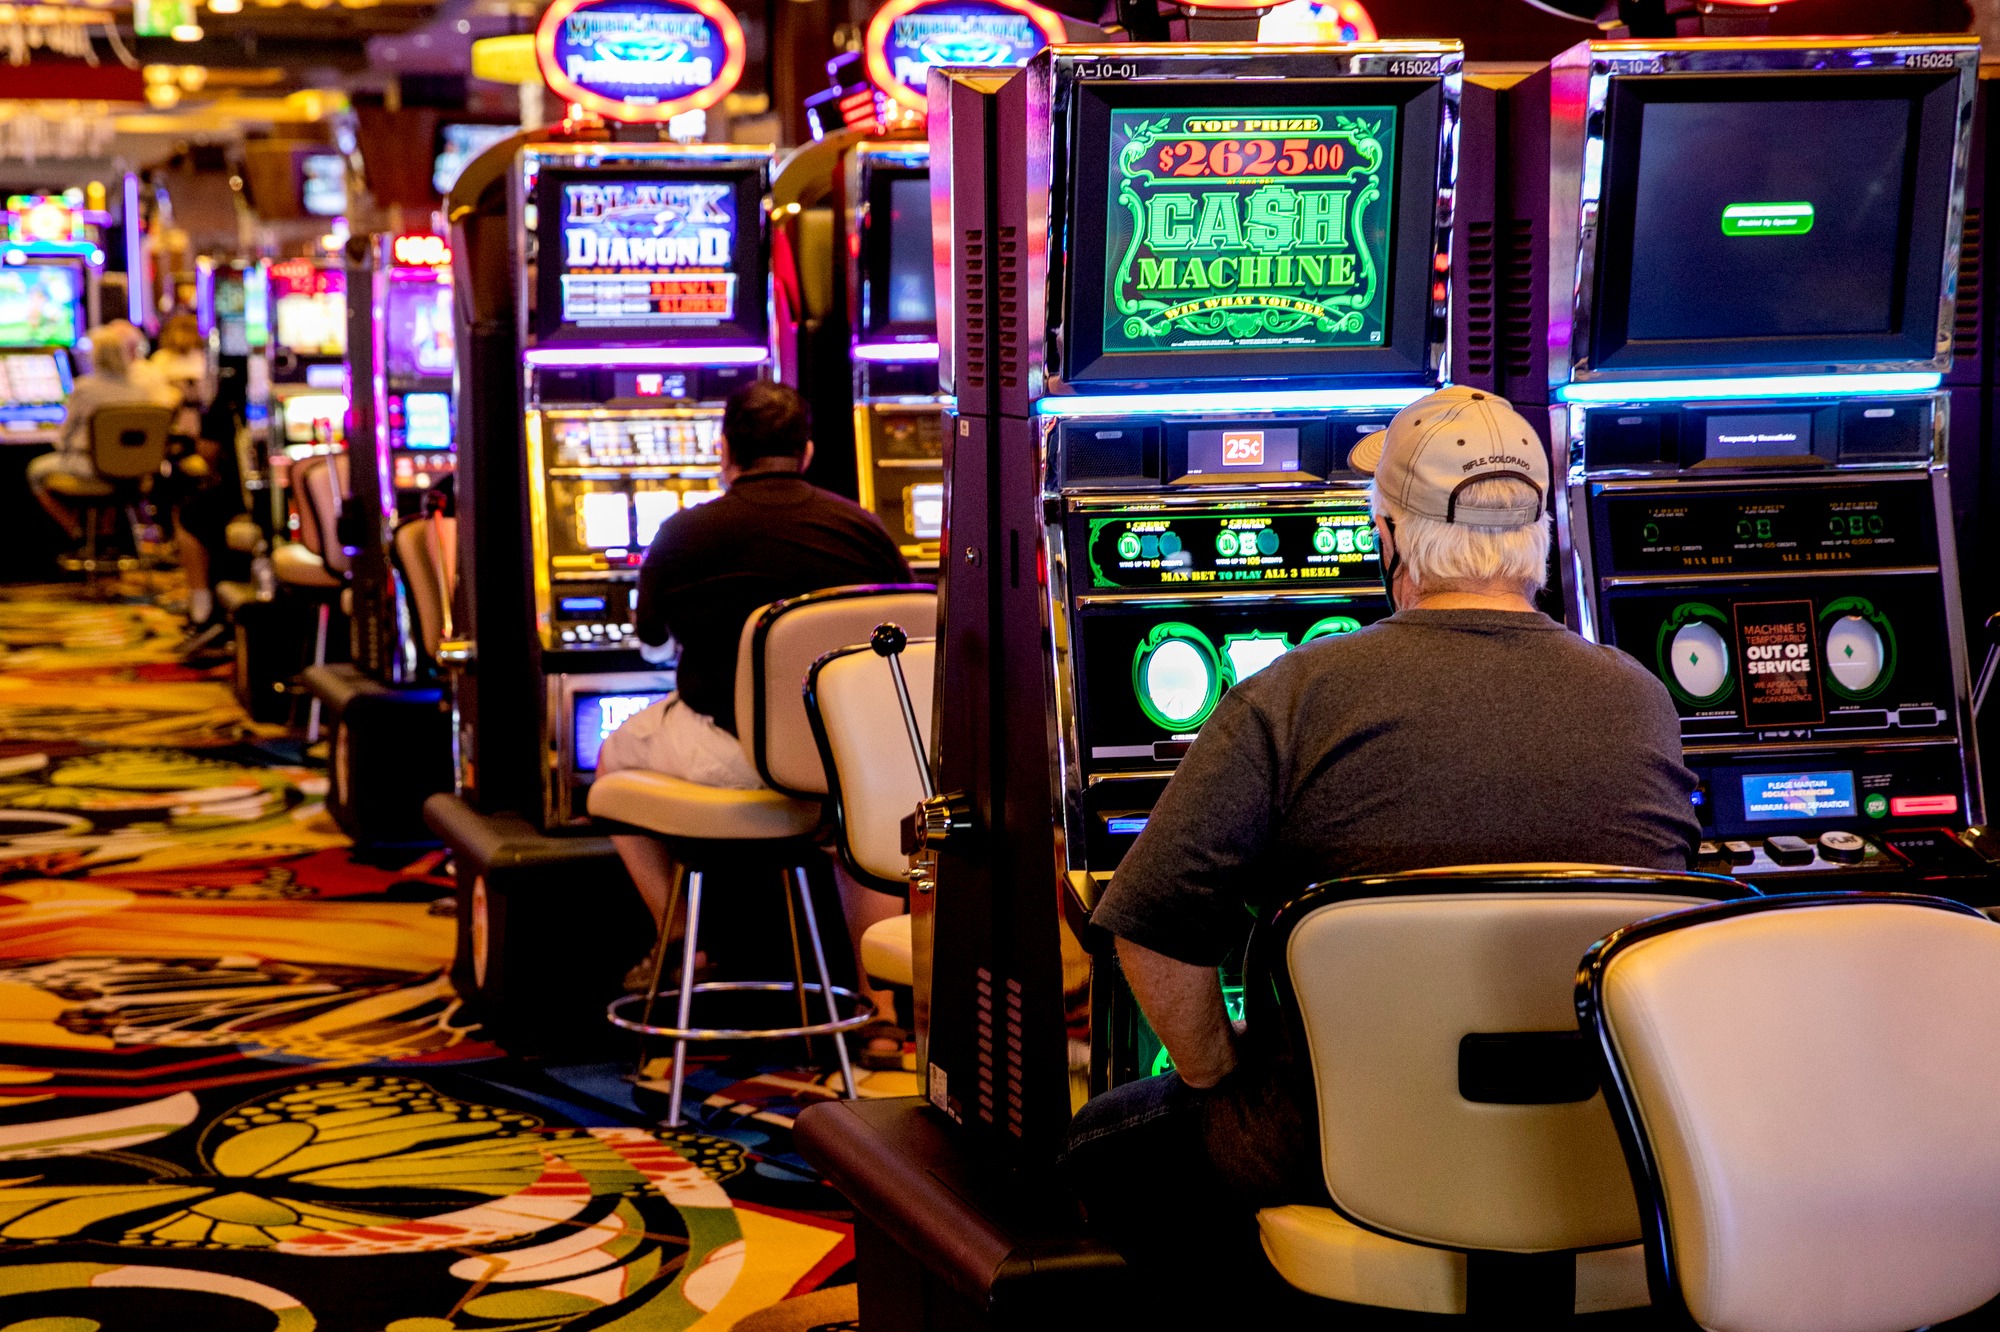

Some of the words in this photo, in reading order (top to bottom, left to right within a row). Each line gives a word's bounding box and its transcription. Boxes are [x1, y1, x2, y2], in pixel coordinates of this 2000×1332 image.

[1390, 61, 1439, 75] 415024
[1610, 60, 1660, 73] A-10-2
[1906, 54, 1954, 68] 415025
[1075, 64, 1137, 78] A-10-01
[1188, 119, 1238, 132] TOP
[1244, 119, 1318, 132] PRIZE
[1158, 139, 1344, 177] $2,625.00
[565, 185, 730, 224] BLACK
[565, 228, 731, 266] DIAMOND
[1137, 254, 1357, 290] MACHINE
[1164, 302, 1200, 319] WIN
[1204, 296, 1254, 309] WHAT
[1258, 296, 1291, 308] YOU
[1226, 439, 1260, 458] 25¢
[1488, 455, 1530, 471] COLORADO
[1161, 571, 1189, 582] MAX
[1191, 570, 1216, 581] BET
[1218, 571, 1233, 580] TO
[1235, 570, 1262, 580] PLAY
[1264, 568, 1288, 579] ALL
[1290, 568, 1298, 578] 3
[1301, 567, 1340, 578] REELS
[1743, 623, 1794, 635] MACHINE
[1796, 622, 1806, 633] IS
[1746, 634, 1806, 645] TEMPORARILY
[1747, 645, 1782, 660] OUT
[1785, 643, 1808, 658] OF
[1748, 659, 1811, 675] SERVICE
[1768, 781, 1793, 789] PLEASE
[1793, 780, 1827, 788] MAINTAIN
[1762, 790, 1789, 798] SOCIAL
[1789, 788, 1835, 798] DISTANCING
[1750, 803, 1783, 812] MINIMUM
[1807, 800, 1850, 810] SEPARATION
[1827, 836, 1856, 846] PLAY
